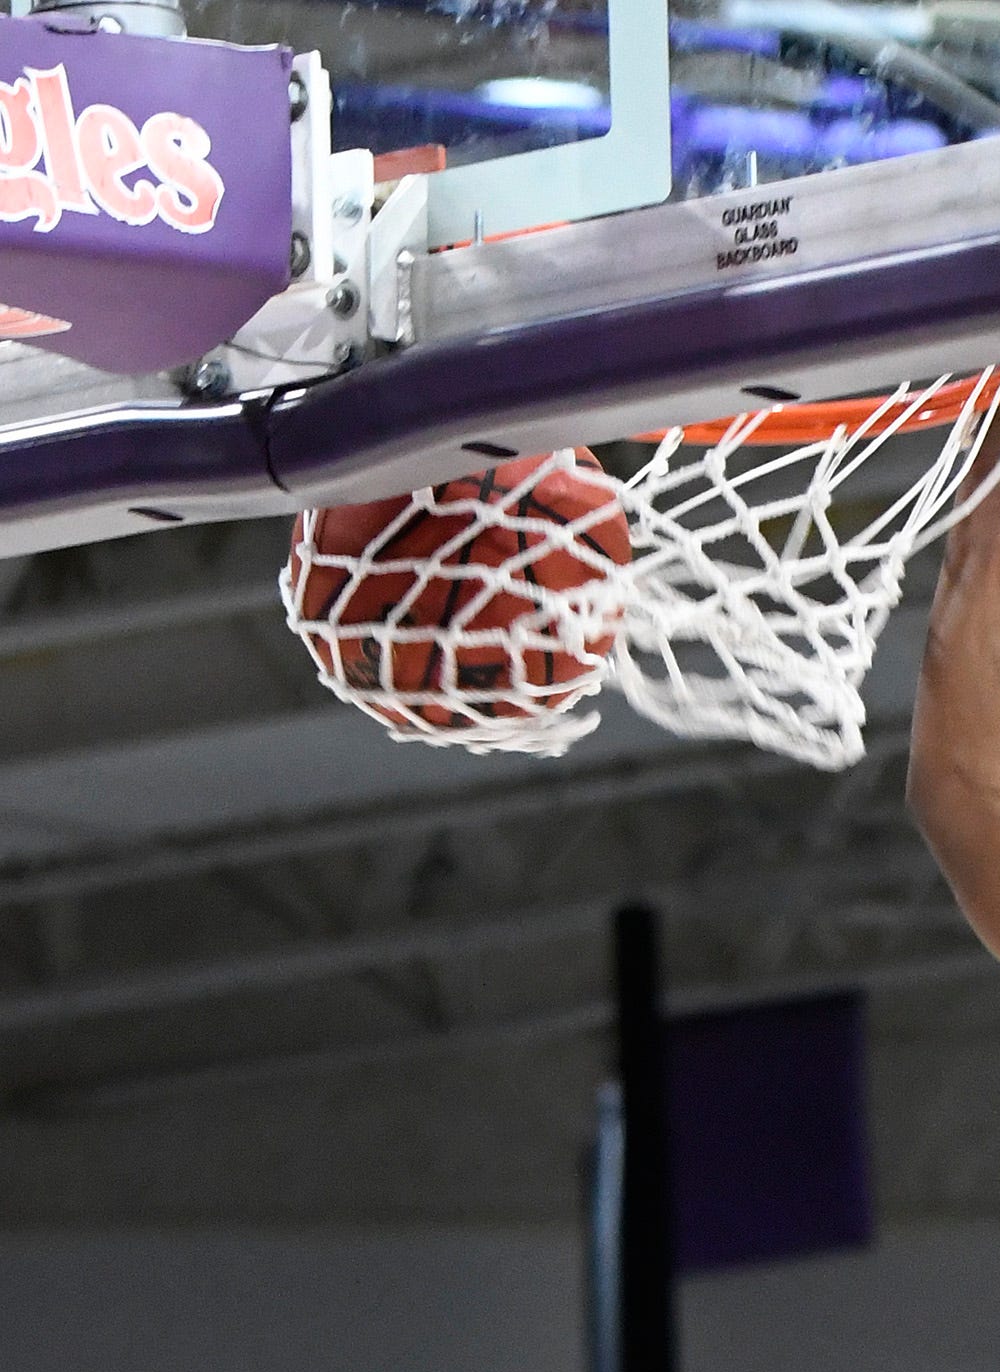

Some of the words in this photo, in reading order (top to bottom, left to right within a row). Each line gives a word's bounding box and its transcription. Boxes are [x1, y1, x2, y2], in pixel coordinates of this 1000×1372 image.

[721, 196, 793, 226] GUARDIAN
[734, 220, 778, 245] GLASS
[716, 237, 799, 271] BACKBOARD
